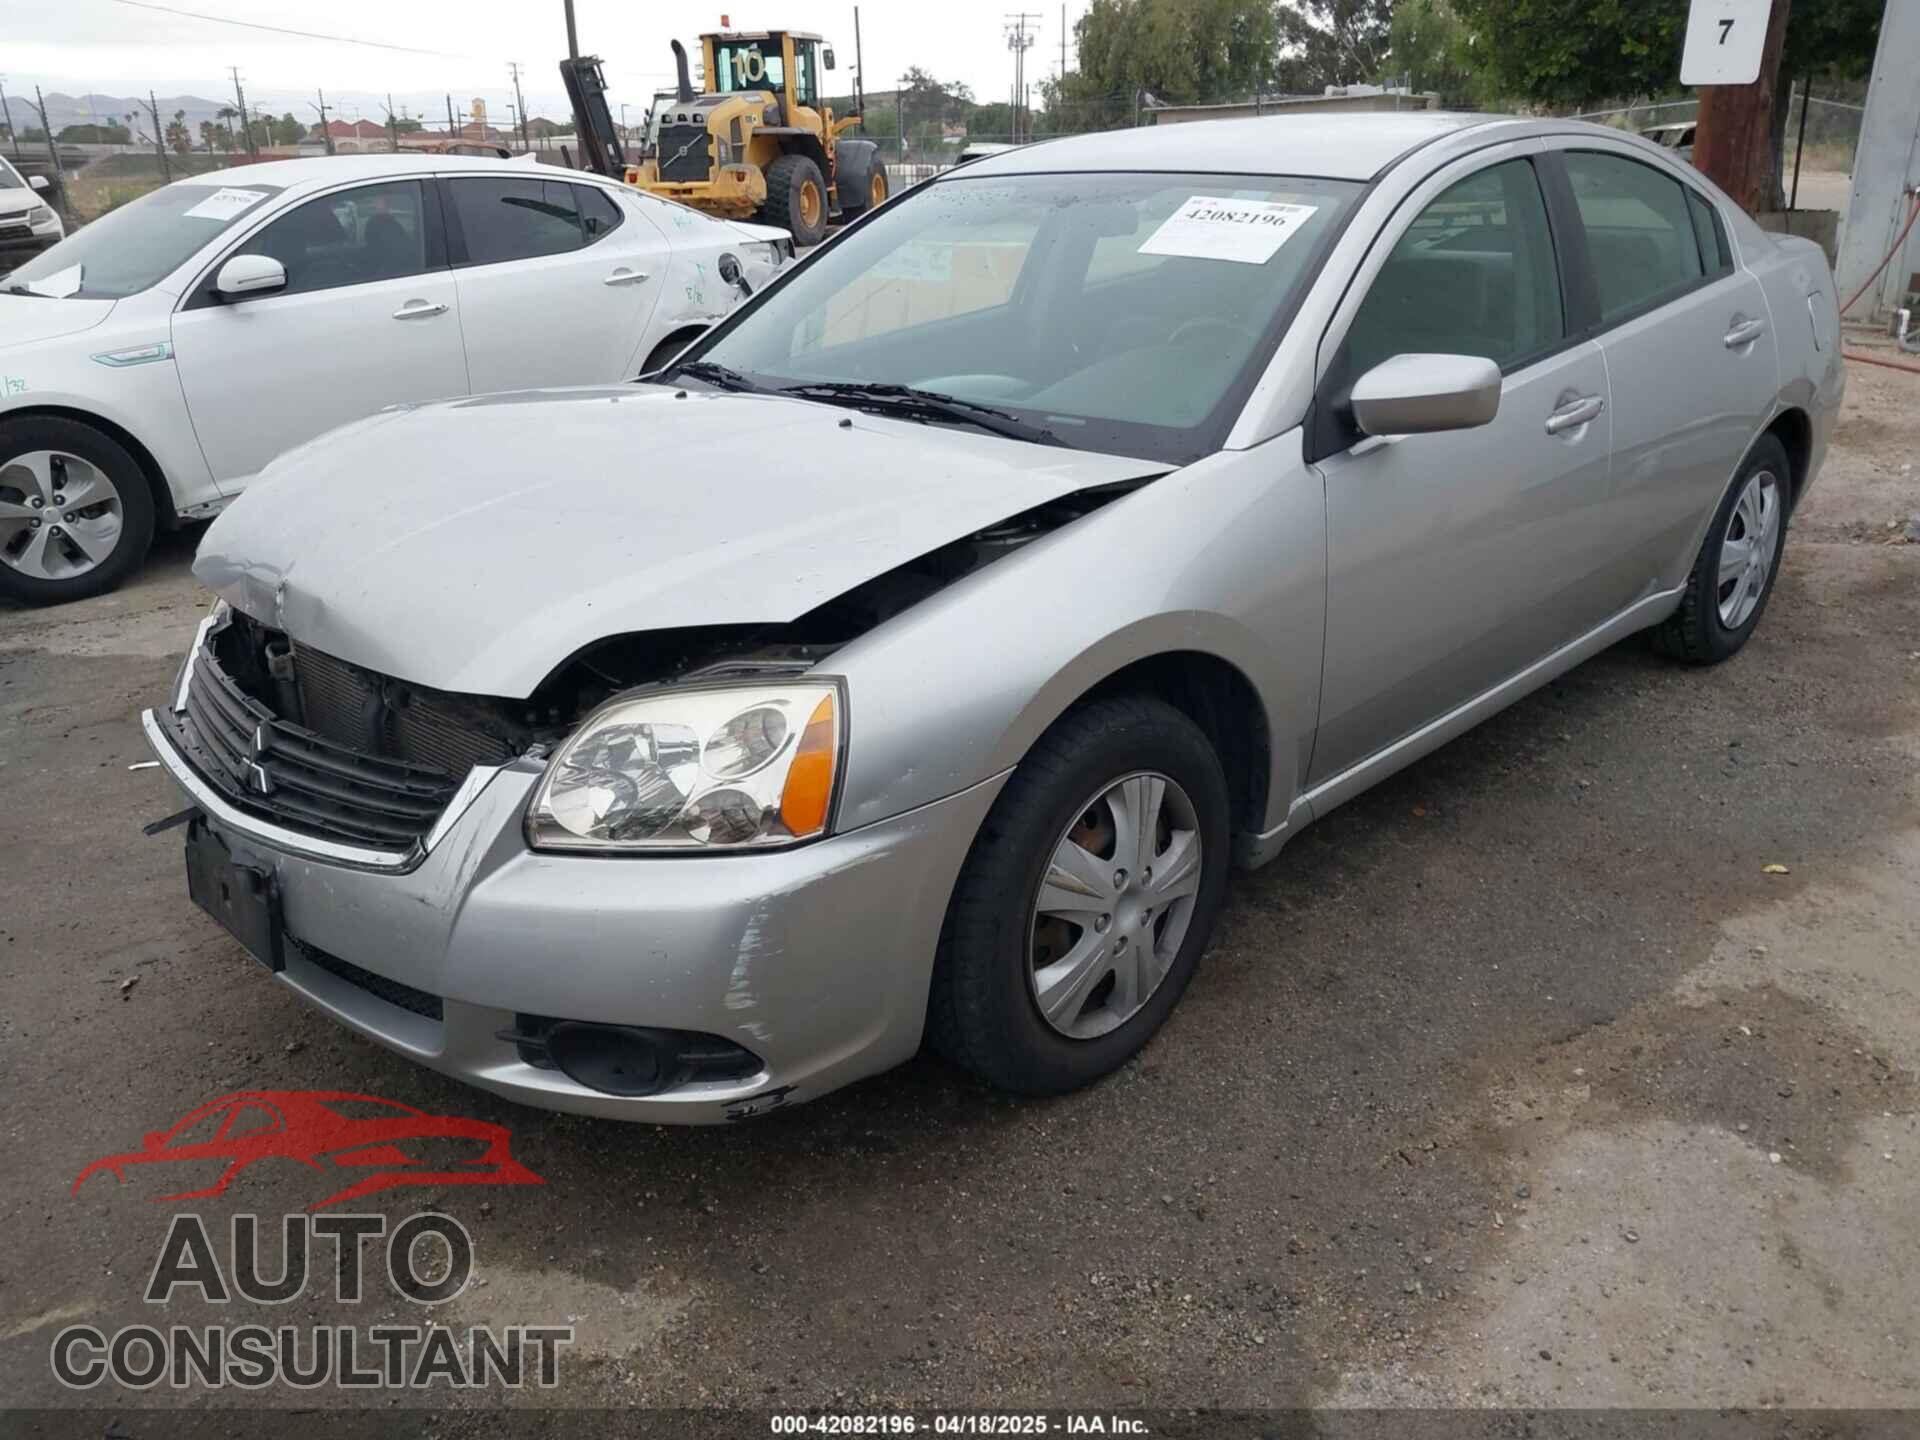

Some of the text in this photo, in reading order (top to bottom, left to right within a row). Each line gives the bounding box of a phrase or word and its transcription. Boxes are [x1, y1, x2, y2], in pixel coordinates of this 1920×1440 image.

[1719, 19, 1735, 45] 7
[731, 50, 765, 82] 10
[1186, 208, 1287, 227] 42082196
